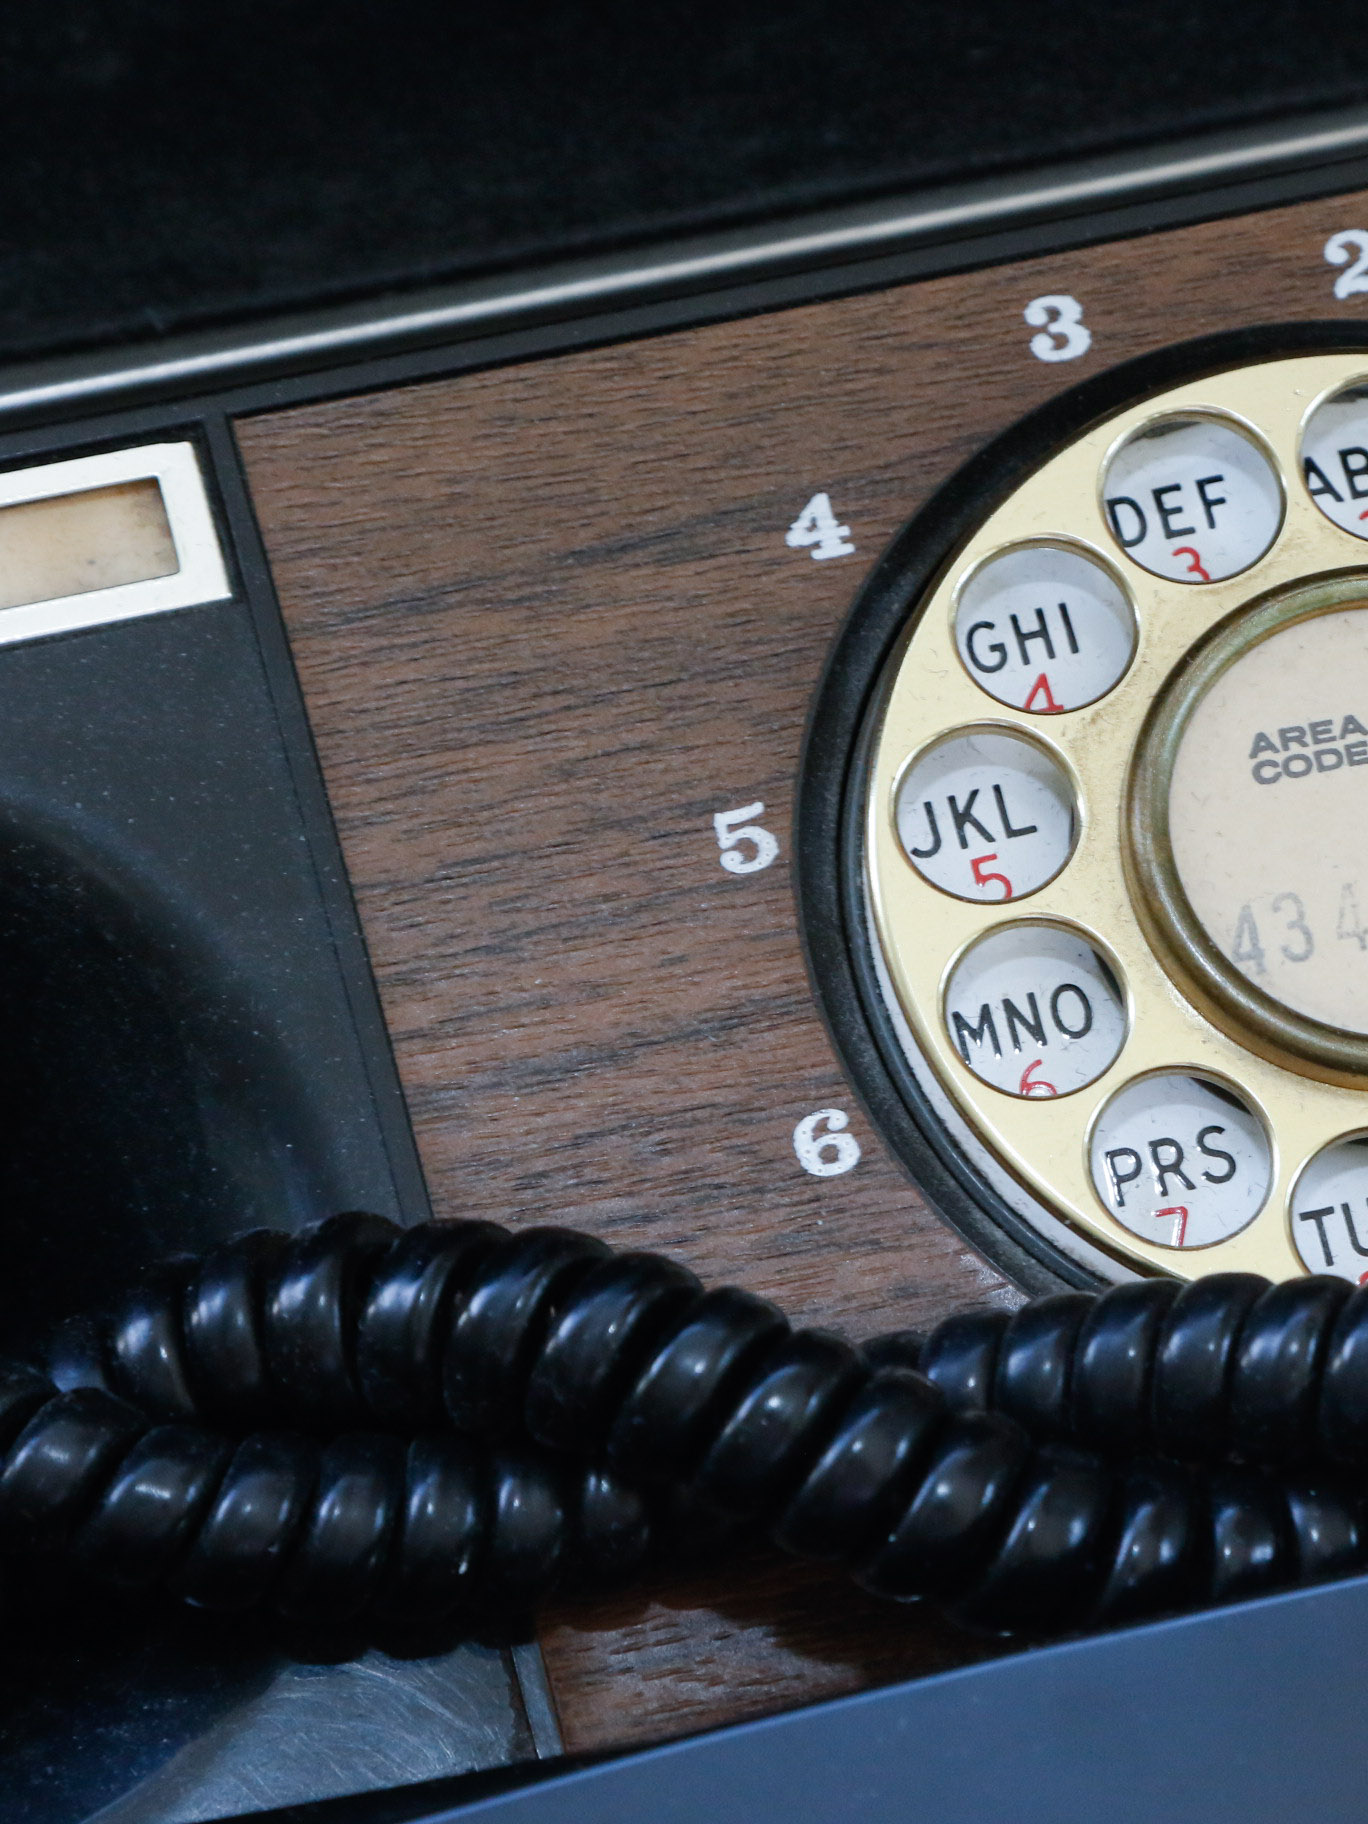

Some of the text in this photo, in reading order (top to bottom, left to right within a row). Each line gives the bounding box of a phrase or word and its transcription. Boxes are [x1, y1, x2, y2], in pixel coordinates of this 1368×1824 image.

[1024, 295, 1092, 362] 3
[786, 493, 855, 560] 4
[1107, 475, 1227, 548] DEF
[966, 602, 1079, 673] GHI
[1023, 672, 1065, 713] 4
[713, 801, 780, 874] 5
[910, 784, 1037, 859] JKL
[970, 853, 1014, 901] 5
[951, 983, 1093, 1066] MNO
[793, 1108, 862, 1177] 6
[1104, 1125, 1237, 1208] PRS
[1154, 1206, 1188, 1247] 7
